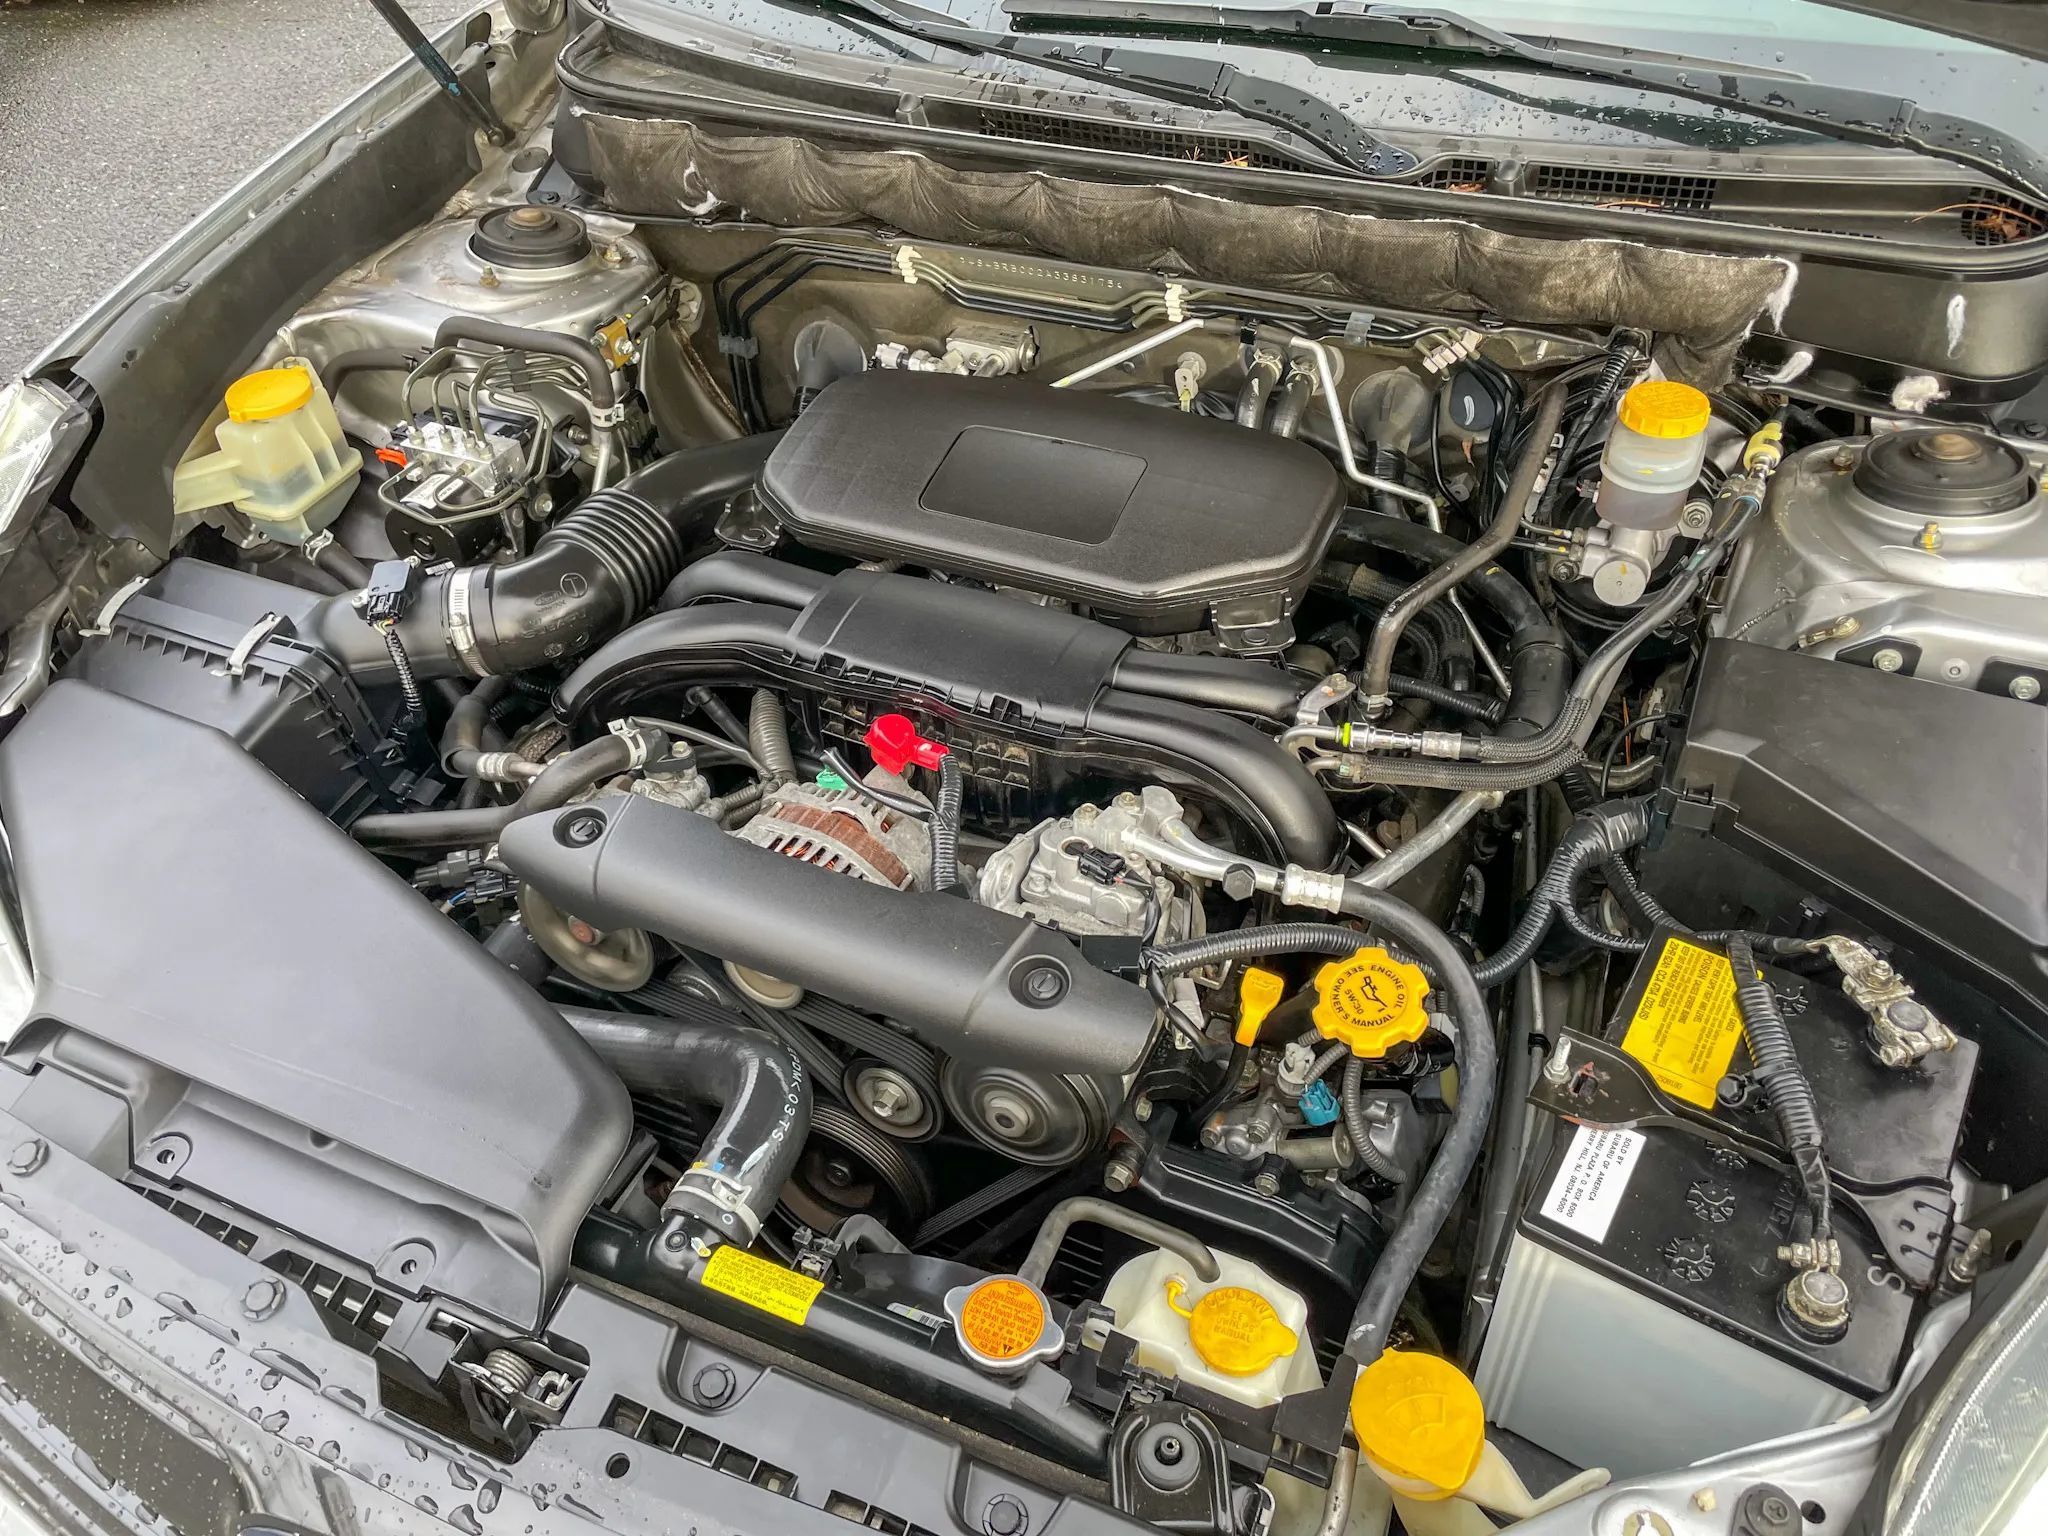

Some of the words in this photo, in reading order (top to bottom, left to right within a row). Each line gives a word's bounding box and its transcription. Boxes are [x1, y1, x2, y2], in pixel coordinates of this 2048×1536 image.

[1345, 965, 1365, 978] SEE
[1696, 954, 1713, 980] POISON
[1370, 964, 1405, 990] ENGINE
[1394, 993, 1405, 1009] OIL
[1331, 977, 1351, 1020] OWNER'S
[1344, 988, 1365, 1015] 5W-30
[1351, 1014, 1396, 1027] MANUAL
[1586, 1128, 1597, 1146] ERRY
[1595, 1129, 1609, 1151] UBARU
[1605, 1133, 1621, 1159] SUBARU
[1620, 1137, 1631, 1154] SOLD
[1586, 1152, 1599, 1171] PLAZA
[1601, 1160, 1609, 1170] OF
[1615, 1155, 1623, 1165] BY
[1573, 1187, 1583, 1201] BOX
[1587, 1171, 1605, 1202] AMERICA
